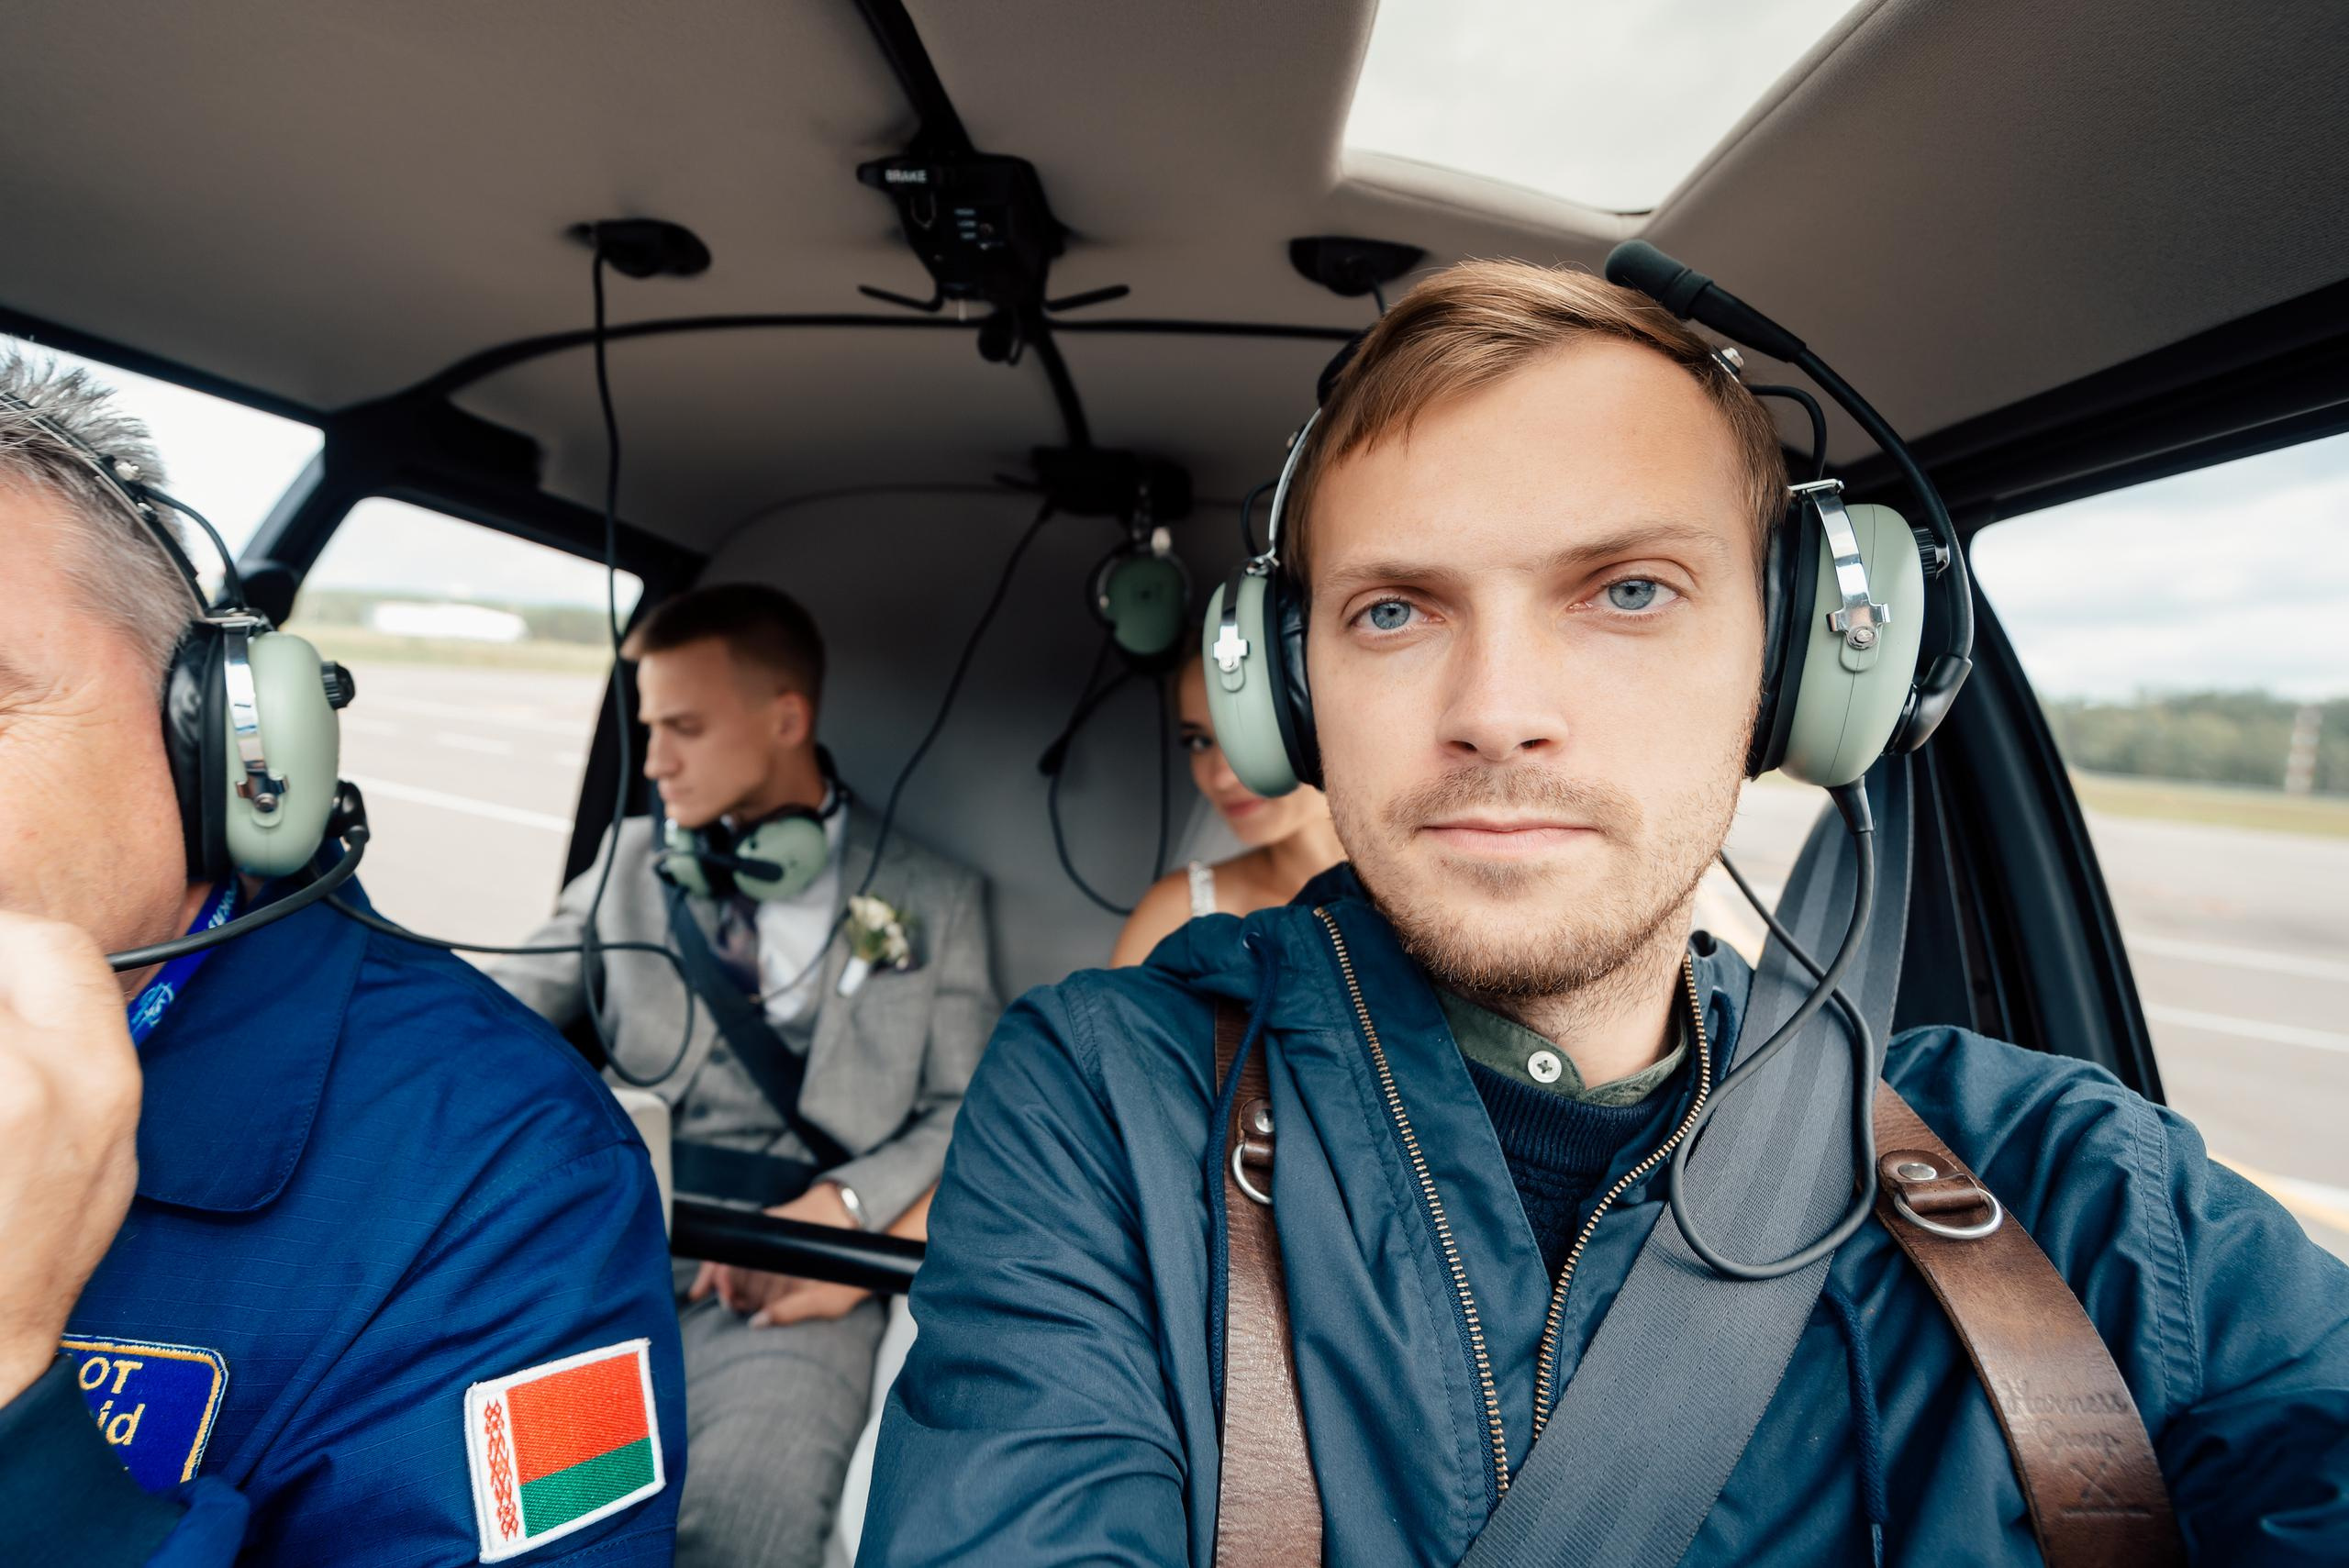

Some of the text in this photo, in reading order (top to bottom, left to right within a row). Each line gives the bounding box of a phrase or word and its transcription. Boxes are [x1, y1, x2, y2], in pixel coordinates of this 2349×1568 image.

[885, 169, 927, 183] BRAKE
[78, 1356, 143, 1395] OT
[95, 1399, 146, 1446] id
